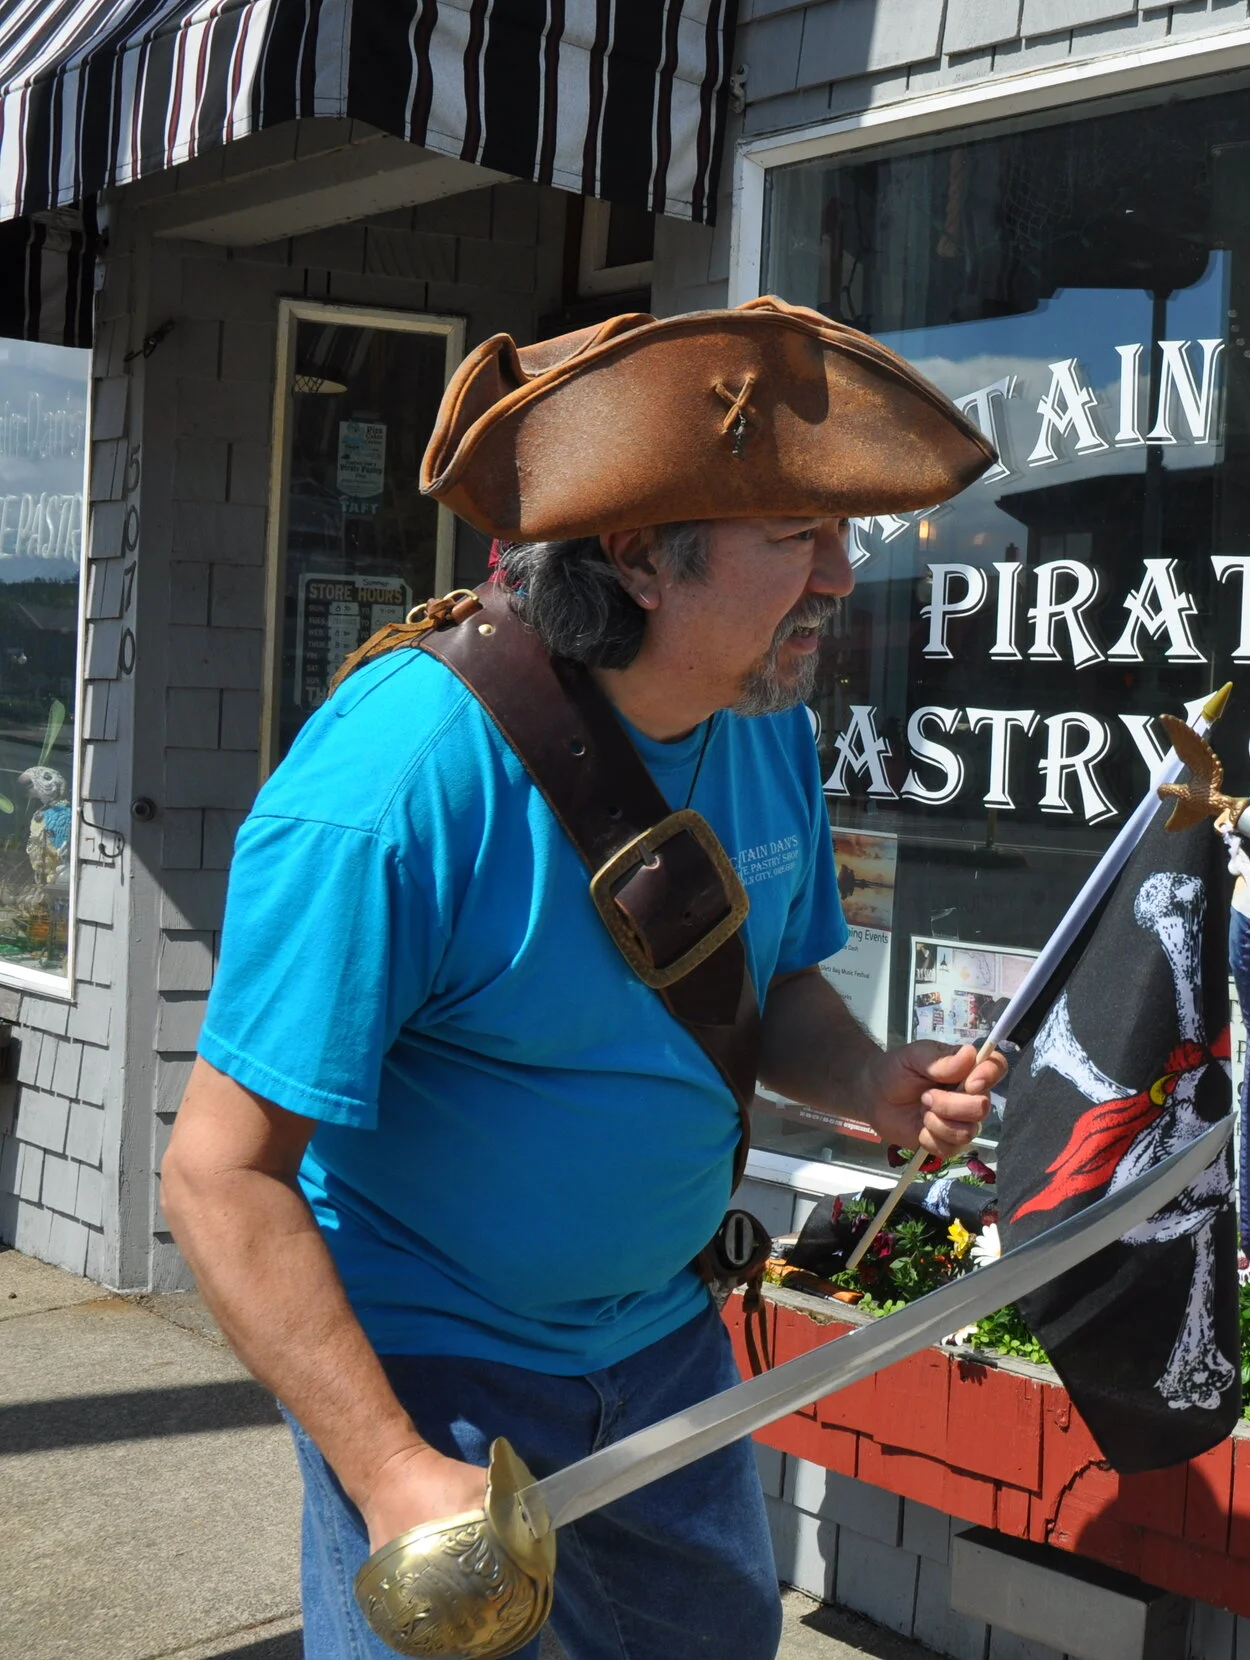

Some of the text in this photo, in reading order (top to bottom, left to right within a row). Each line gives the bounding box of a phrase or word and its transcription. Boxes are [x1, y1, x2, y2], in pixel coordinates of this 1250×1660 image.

[119, 443, 141, 676] 5070
[309, 583, 403, 604] STORE HOURS
[812, 691, 1218, 827] ASTRY
[769, 834, 799, 855] DAN'S
[751, 853, 782, 873] PASTRY
[864, 930, 889, 944] Events
[854, 971, 870, 979] Festival
